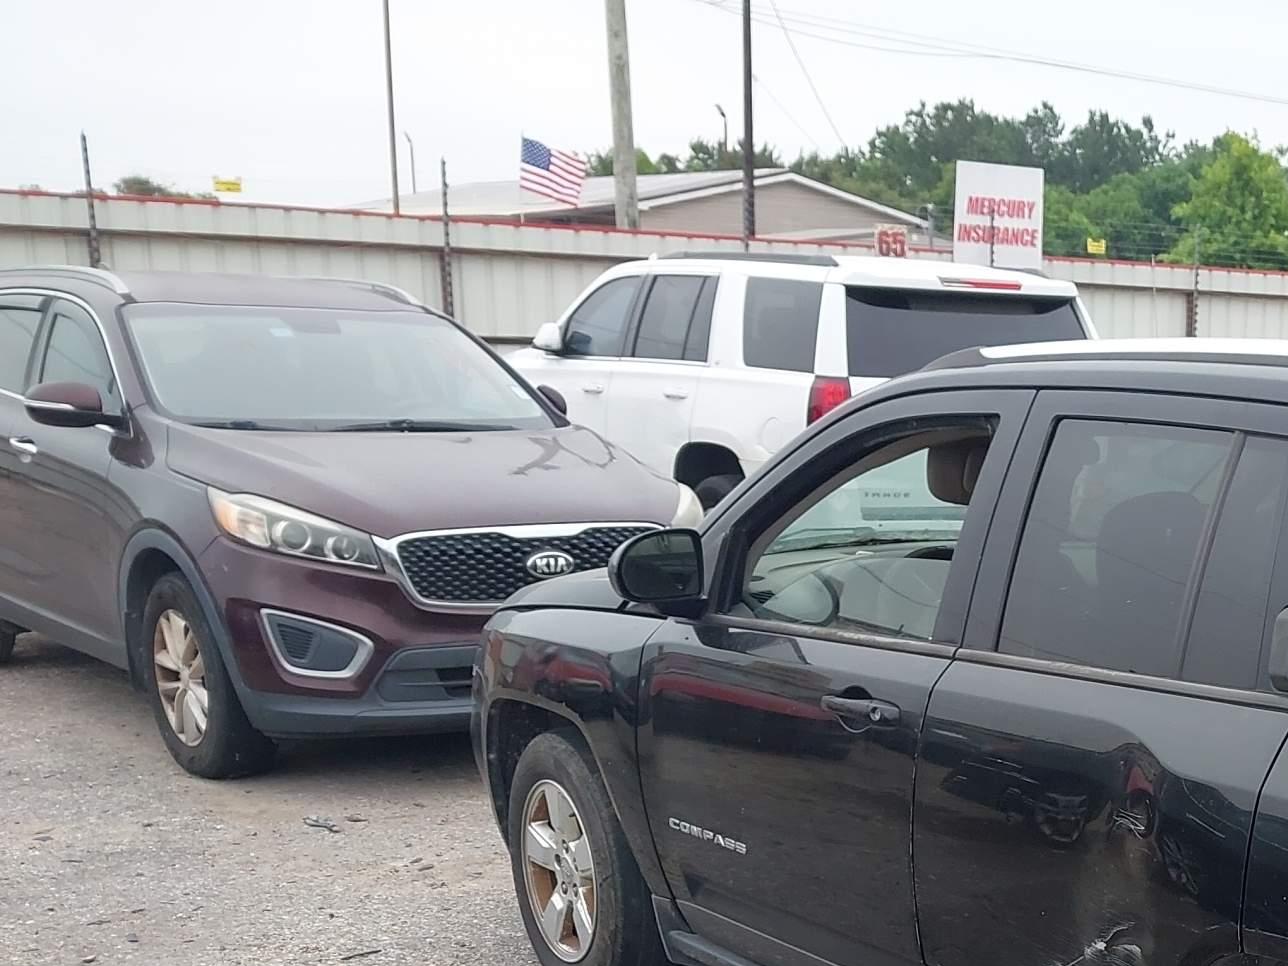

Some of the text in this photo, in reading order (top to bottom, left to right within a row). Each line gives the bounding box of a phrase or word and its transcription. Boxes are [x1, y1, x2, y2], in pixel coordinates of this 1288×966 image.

[966, 196, 1035, 220] MERCURY
[878, 230, 906, 257] 65
[957, 223, 1039, 247] INSURANCE
[535, 556, 568, 574] KIA
[668, 816, 747, 855] COMPASS
